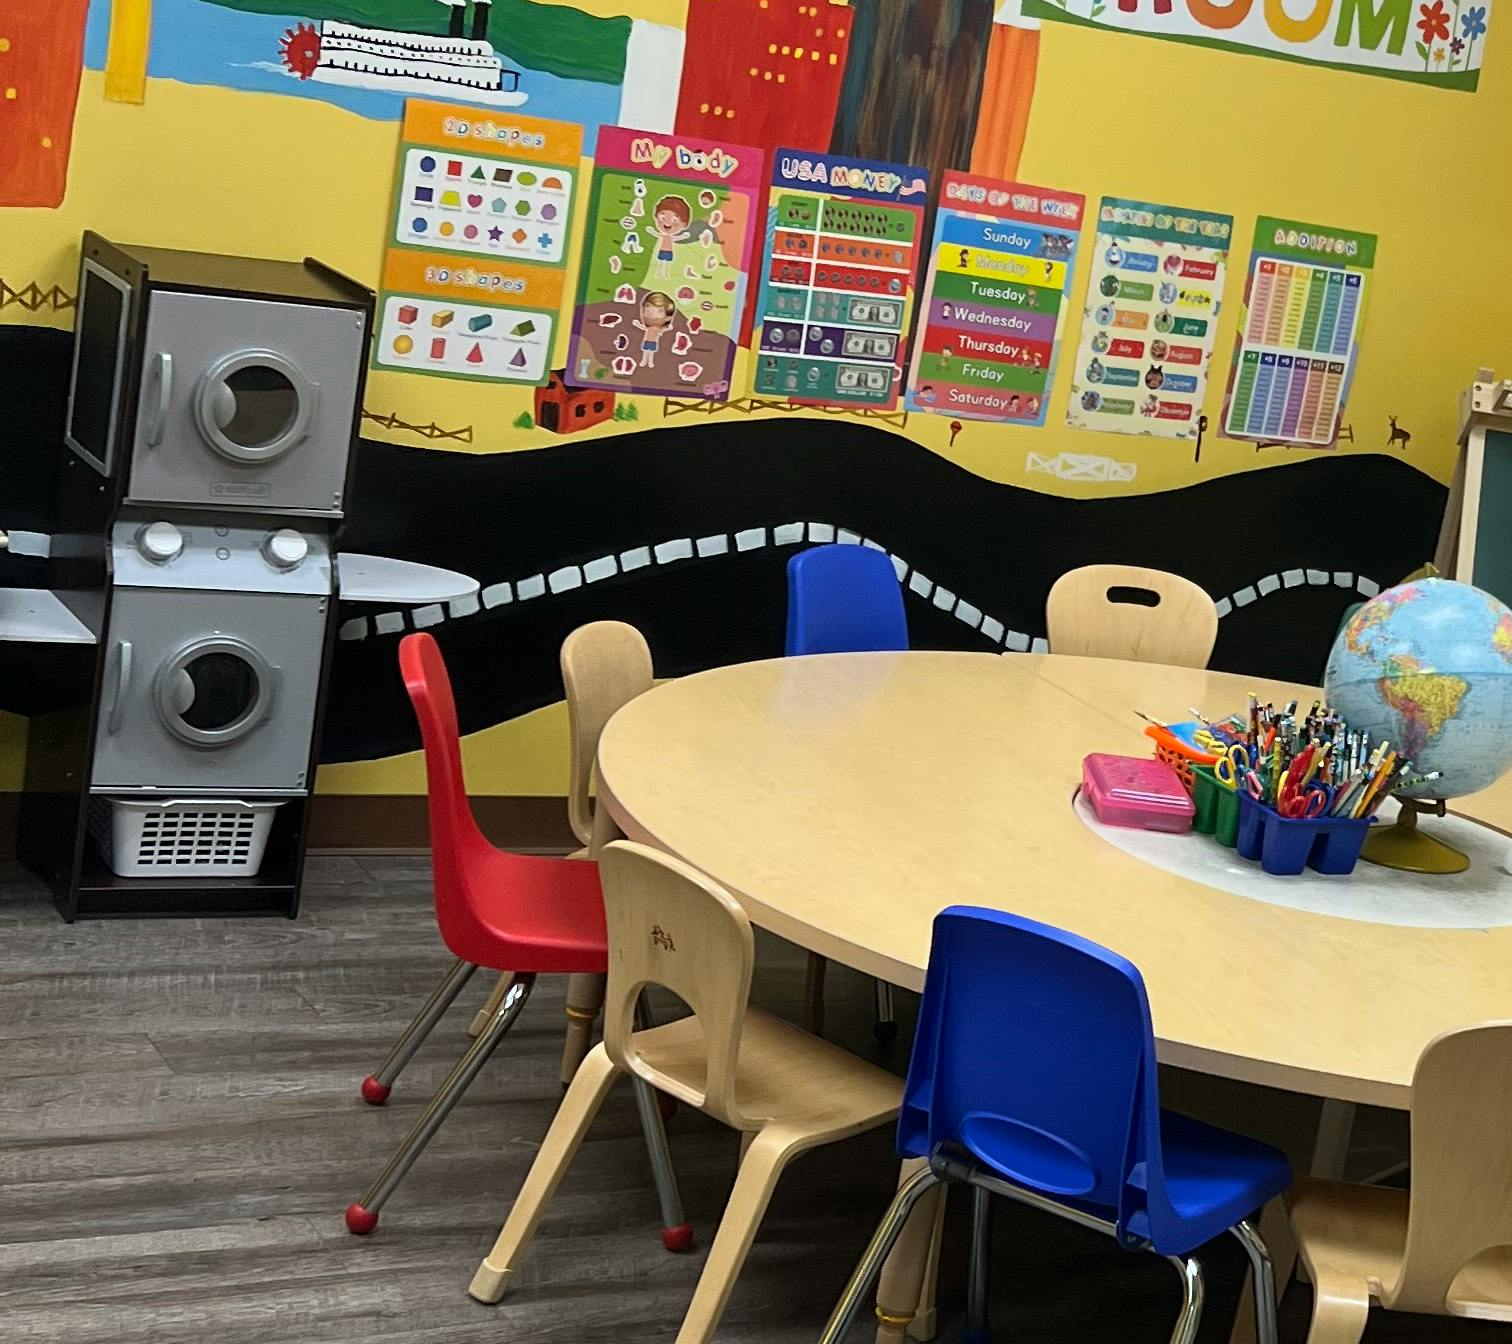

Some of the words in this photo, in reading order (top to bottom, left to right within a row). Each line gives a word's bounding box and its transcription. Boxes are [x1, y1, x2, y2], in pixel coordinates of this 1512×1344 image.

[445, 119, 469, 137] 2D
[473, 122, 545, 147] shapes
[631, 138, 672, 168] My
[676, 145, 739, 178] body
[781, 158, 828, 183] USA
[830, 166, 901, 193] MONEY
[983, 227, 1031, 249] Sunday
[975, 254, 1029, 277] Monday
[425, 267, 450, 284] 3D
[453, 269, 527, 293] shapes
[970, 281, 1026, 304] Tuesday
[954, 307, 1032, 332] Wednesday
[959, 335, 1019, 358] Thursday
[962, 364, 1004, 382] Friday
[949, 389, 1009, 410] Saturday
